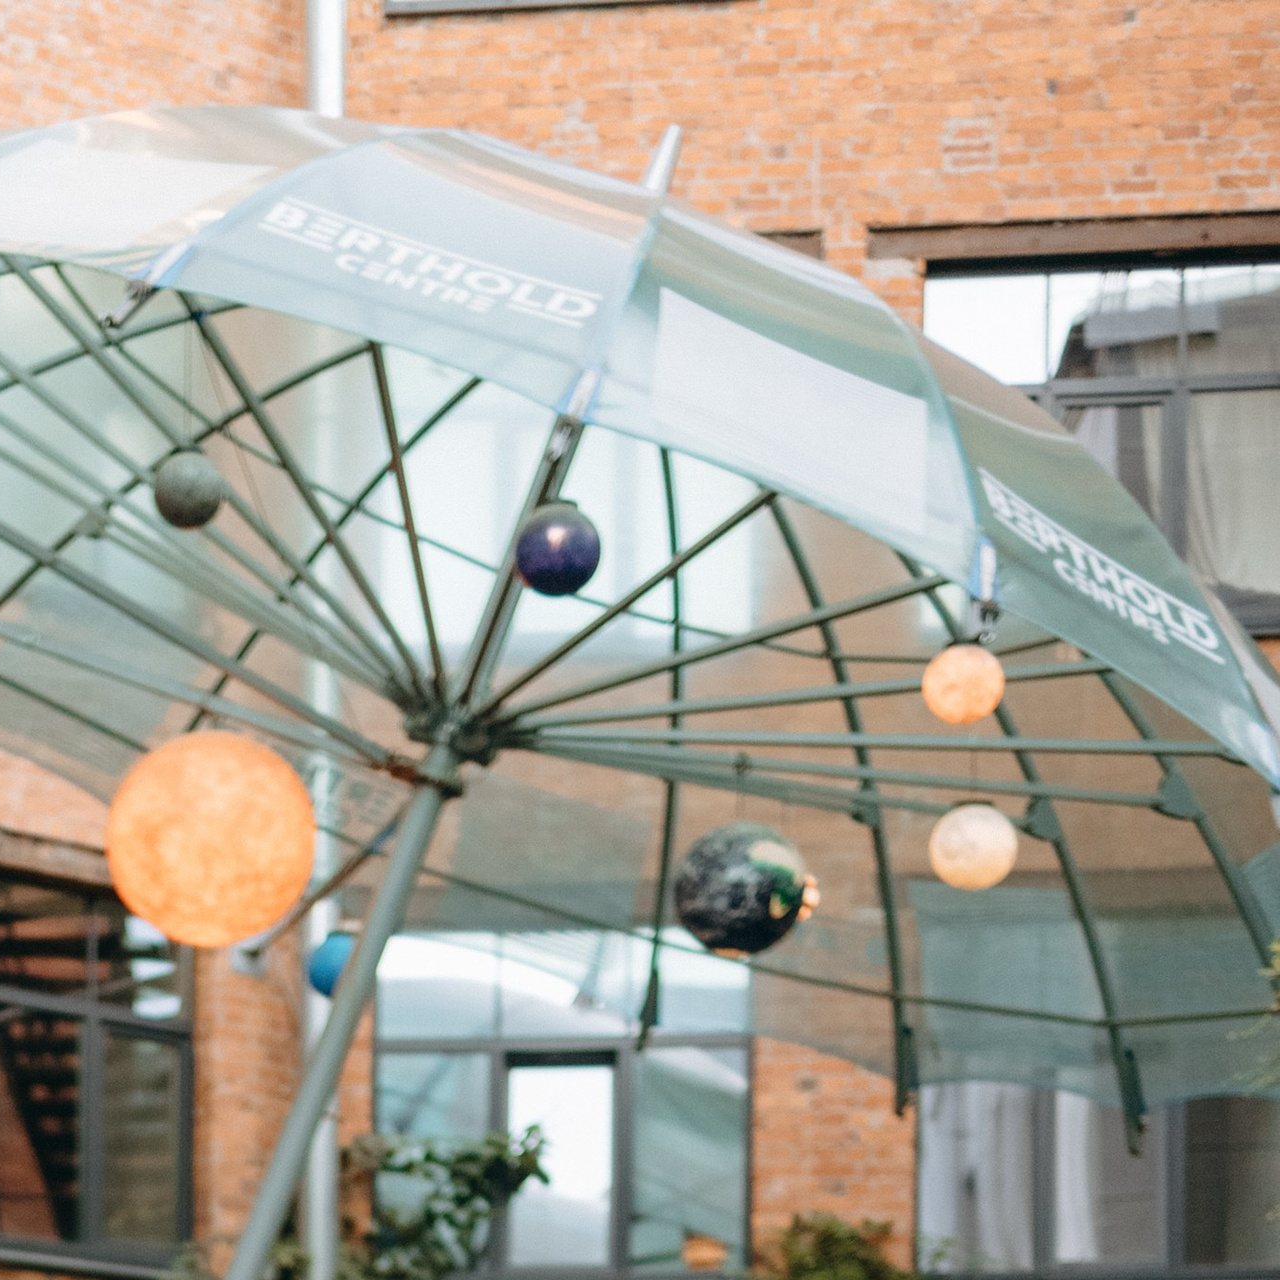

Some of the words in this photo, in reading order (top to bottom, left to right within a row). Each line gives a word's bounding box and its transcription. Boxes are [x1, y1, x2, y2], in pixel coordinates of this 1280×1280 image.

[262, 199, 598, 321] BERTHOLD
[335, 253, 496, 314] CENTRE
[978, 469, 1220, 651] BERTHOLD
[1053, 557, 1169, 644] CENTRE
